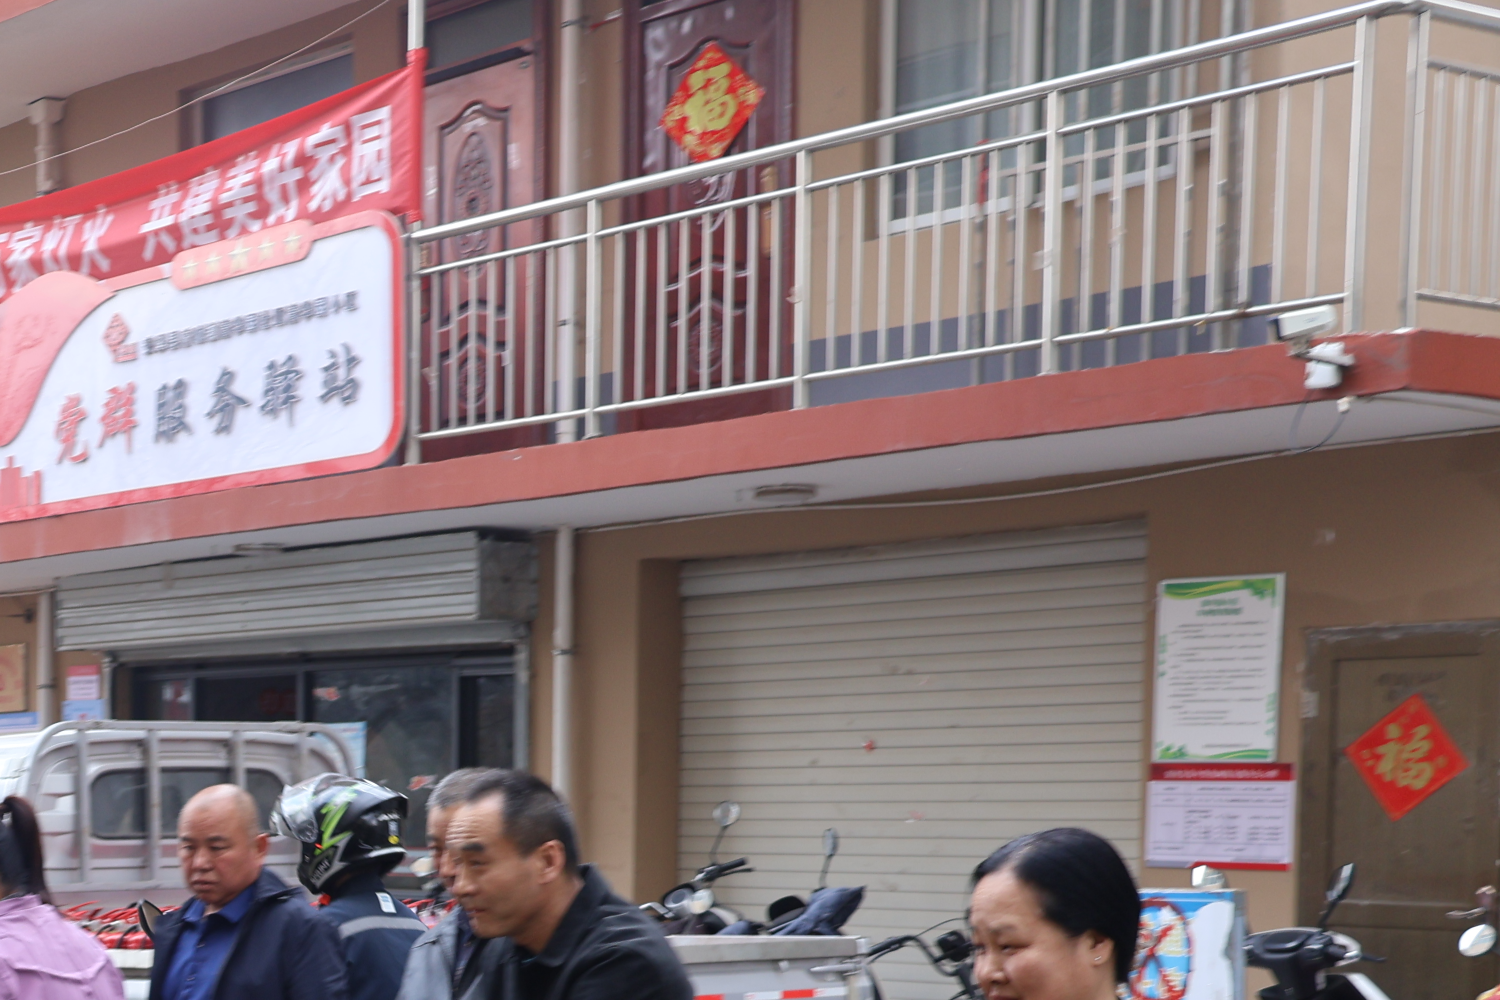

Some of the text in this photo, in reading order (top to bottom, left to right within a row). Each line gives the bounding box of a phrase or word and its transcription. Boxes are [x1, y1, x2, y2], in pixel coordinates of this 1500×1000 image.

[685, 61, 738, 132] 福
[137, 104, 393, 263] 共建美好家园
[54, 342, 363, 466] 党群服务驿站
[1373, 722, 1434, 791] 福
